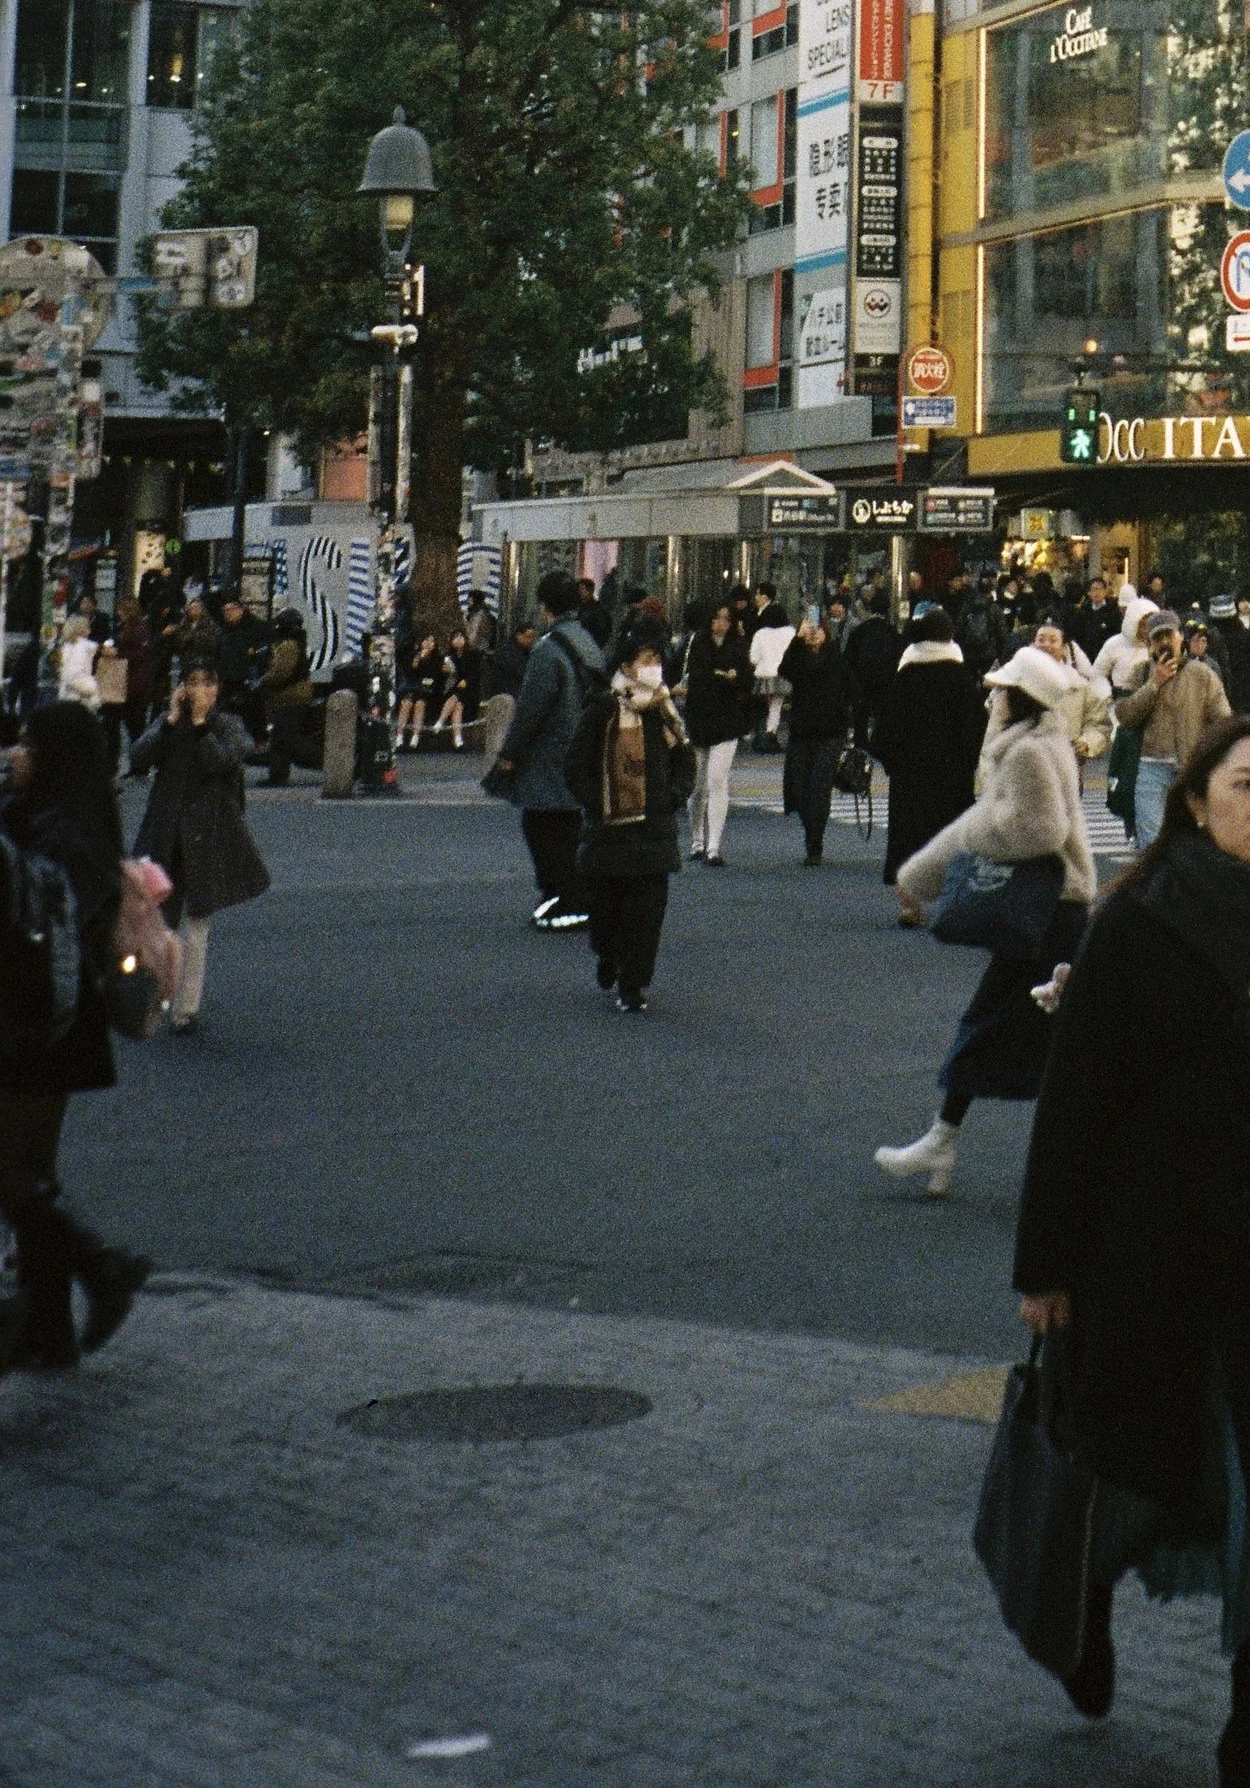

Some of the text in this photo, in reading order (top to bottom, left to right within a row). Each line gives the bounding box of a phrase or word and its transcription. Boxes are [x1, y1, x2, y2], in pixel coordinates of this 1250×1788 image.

[868, 83, 895, 100] 7F
[913, 362, 946, 380] 消火栓
